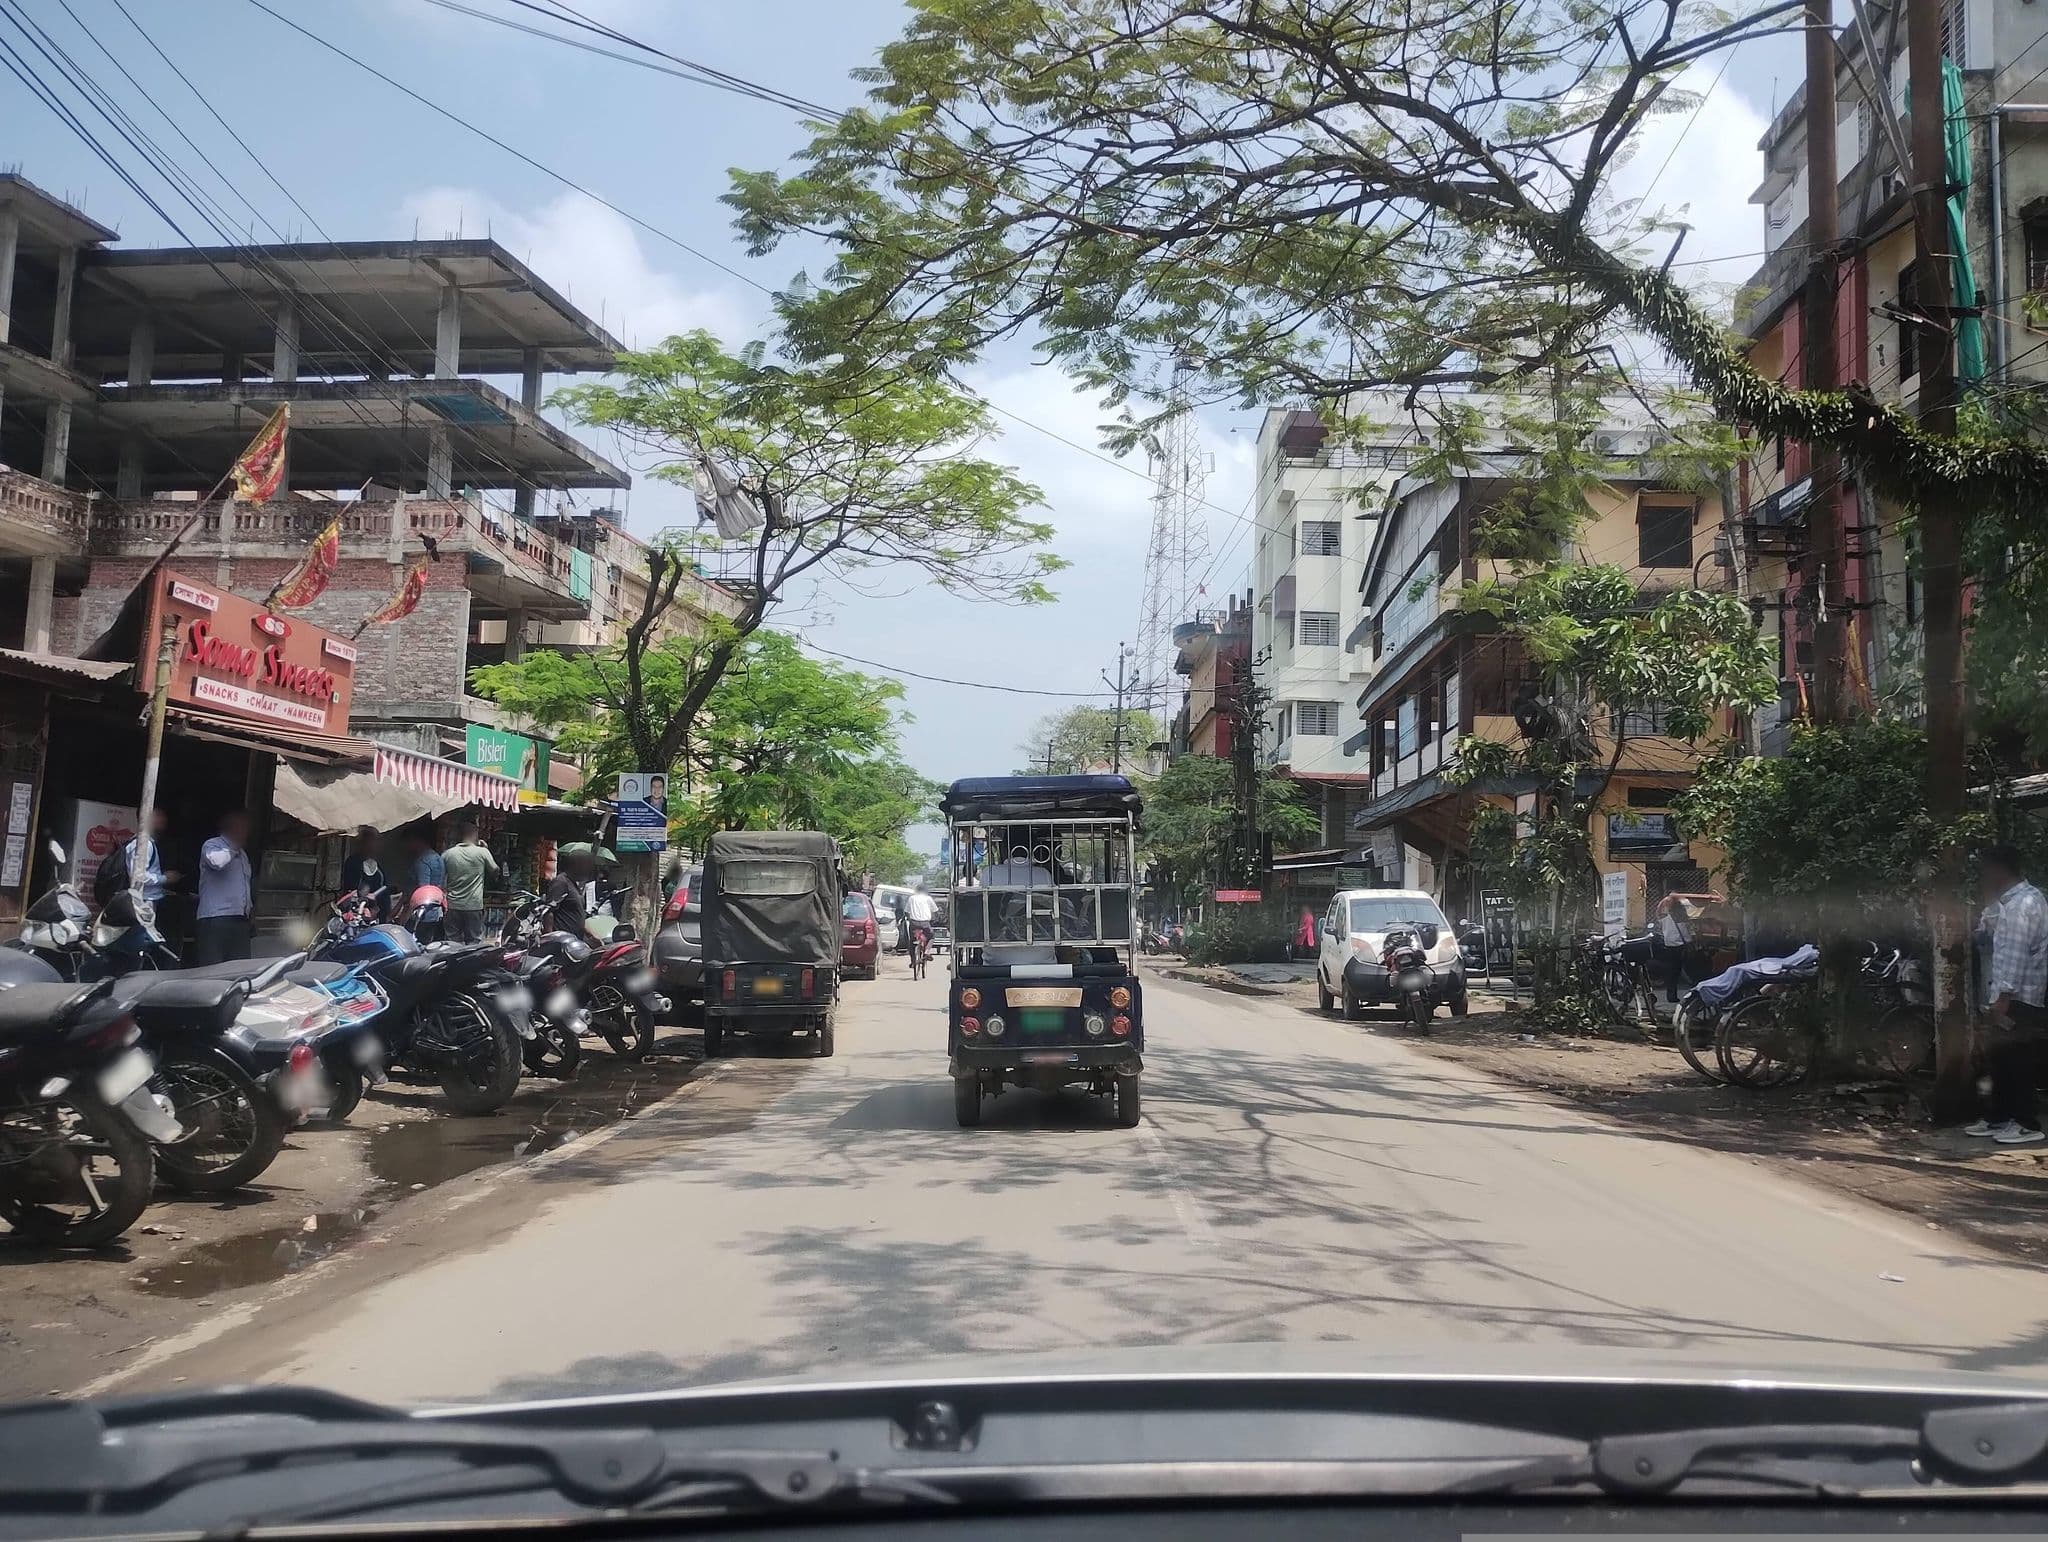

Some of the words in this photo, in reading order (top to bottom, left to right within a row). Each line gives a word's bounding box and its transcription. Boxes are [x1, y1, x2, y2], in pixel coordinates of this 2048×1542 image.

[264, 617, 286, 636] SS
[186, 619, 257, 678] Soma
[262, 644, 335, 703] Sweets
[202, 683, 239, 701] SNACKS
[287, 708, 322, 723] NAMKEEN
[477, 736, 507, 763] Bisleri
